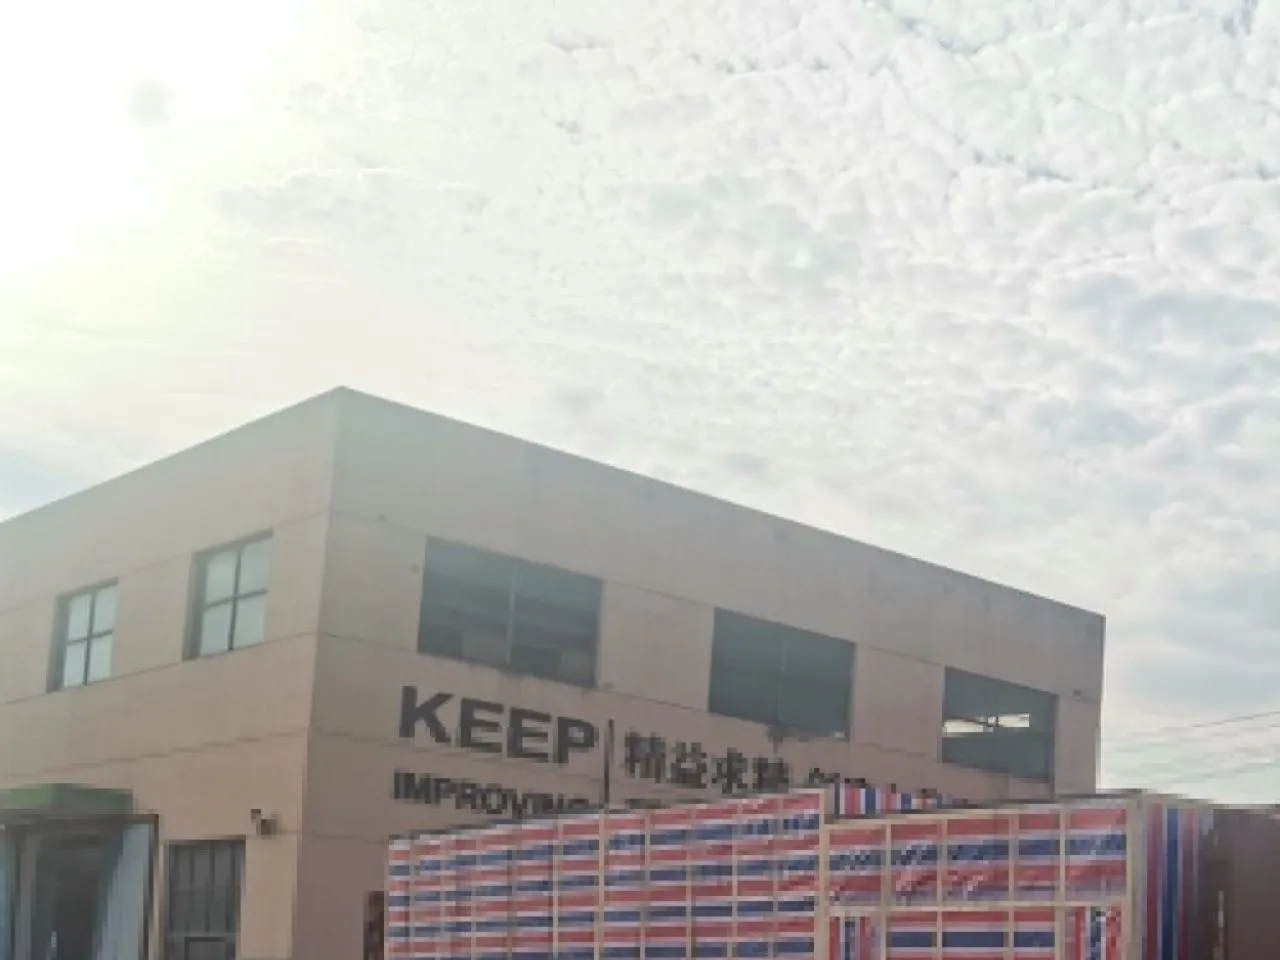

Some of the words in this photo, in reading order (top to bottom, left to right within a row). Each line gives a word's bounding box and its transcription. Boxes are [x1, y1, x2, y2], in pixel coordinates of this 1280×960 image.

[400, 685, 598, 764] KEEP
[624, 730, 790, 794] 精益求精
